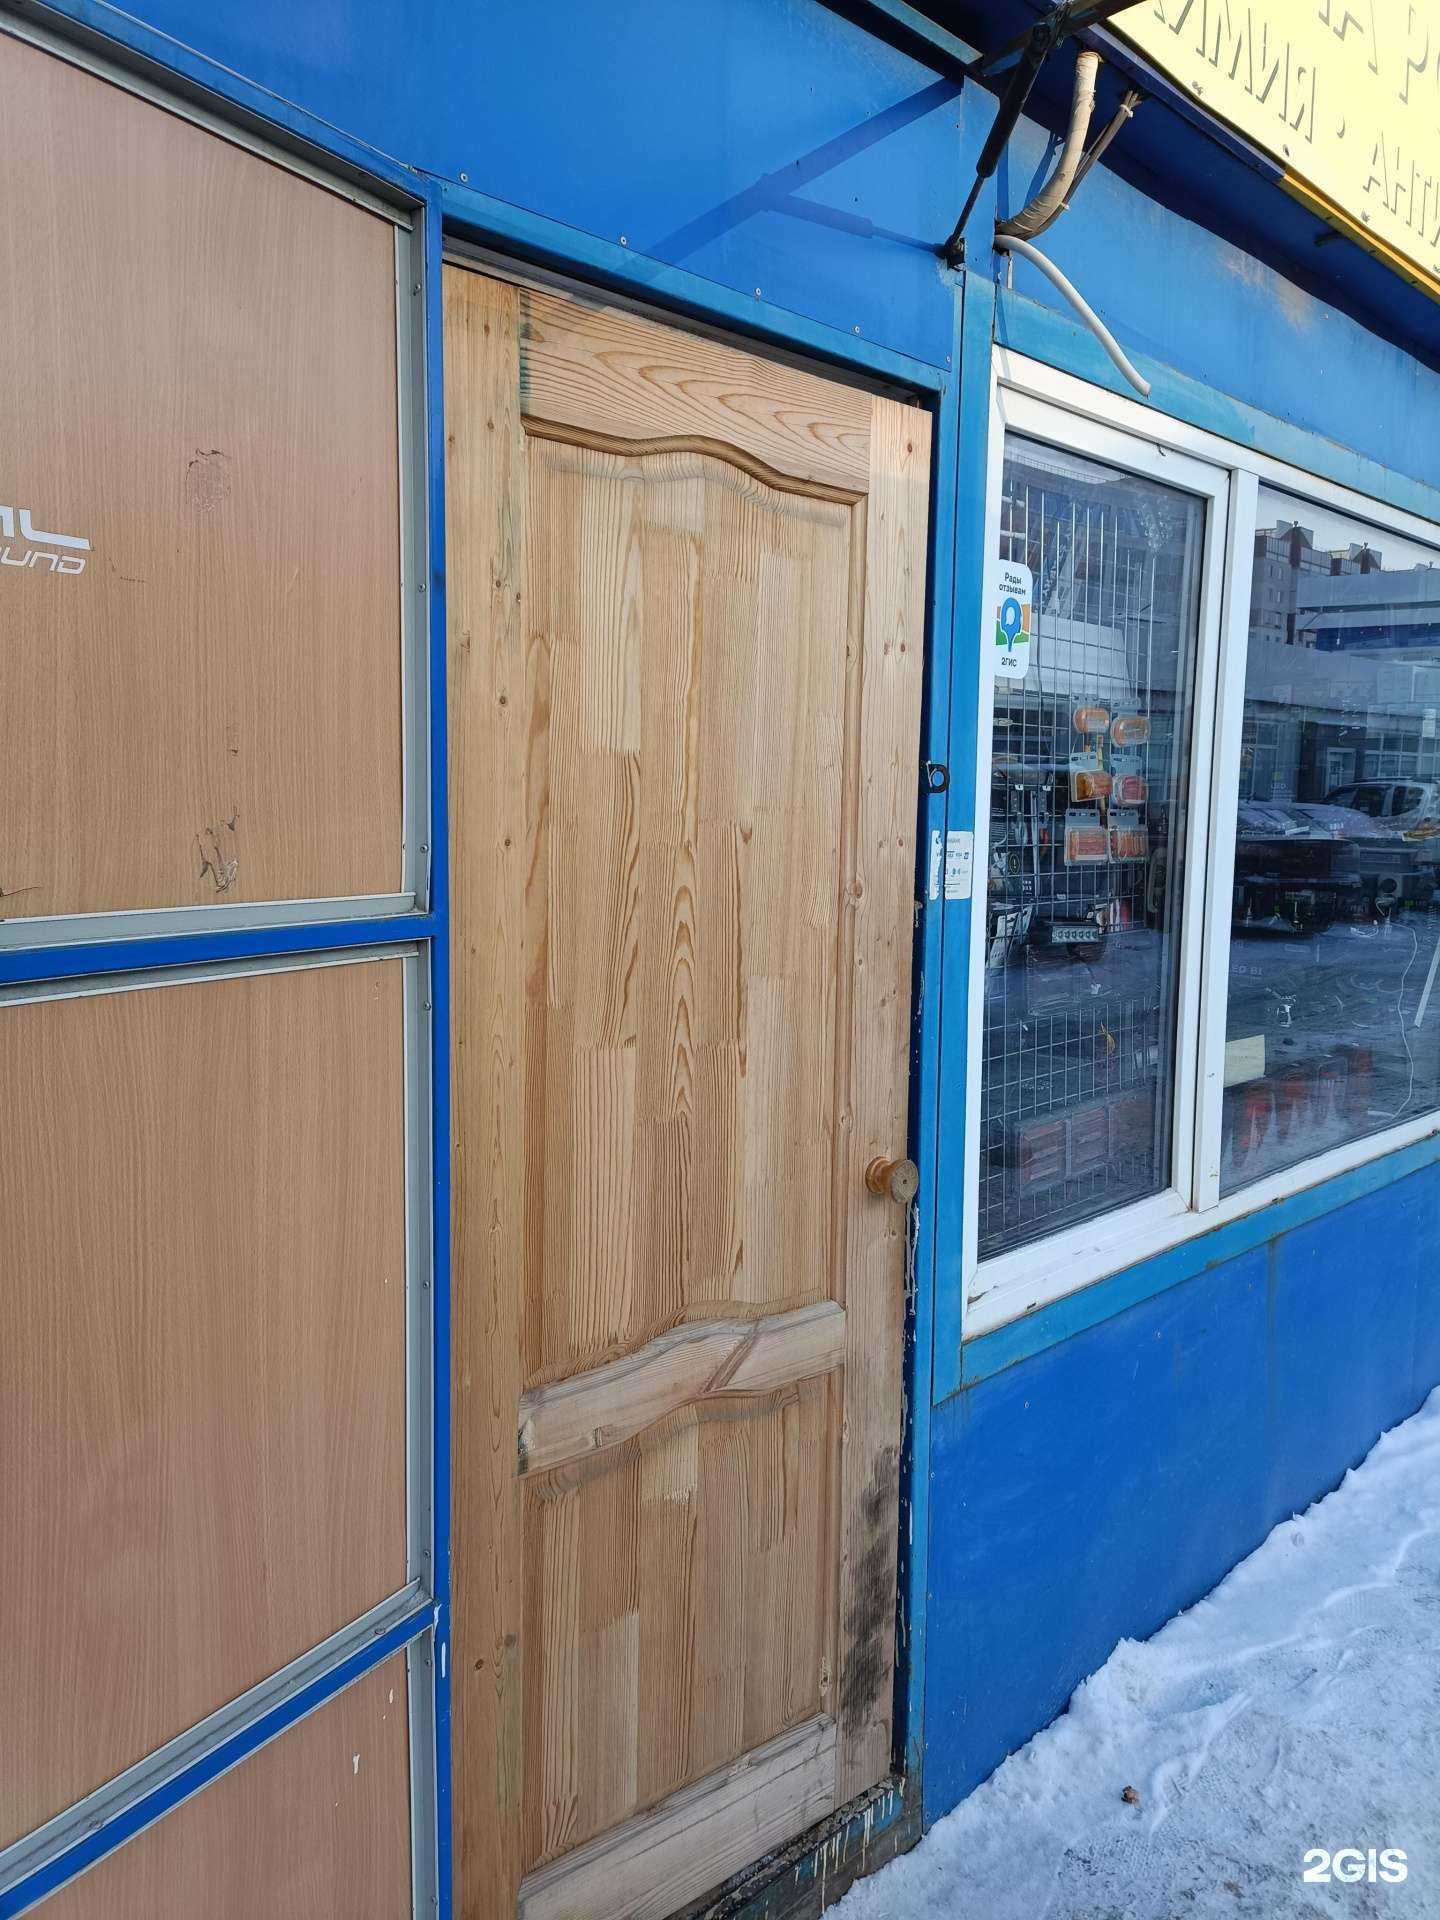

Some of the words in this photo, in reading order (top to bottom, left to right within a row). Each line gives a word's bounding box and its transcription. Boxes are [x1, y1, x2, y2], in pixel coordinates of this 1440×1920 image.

[0, 546, 86, 574] UND
[1004, 571, 1022, 585] Рады
[998, 583, 1026, 596] отзывам
[1001, 656, 1018, 668] 2ГИС
